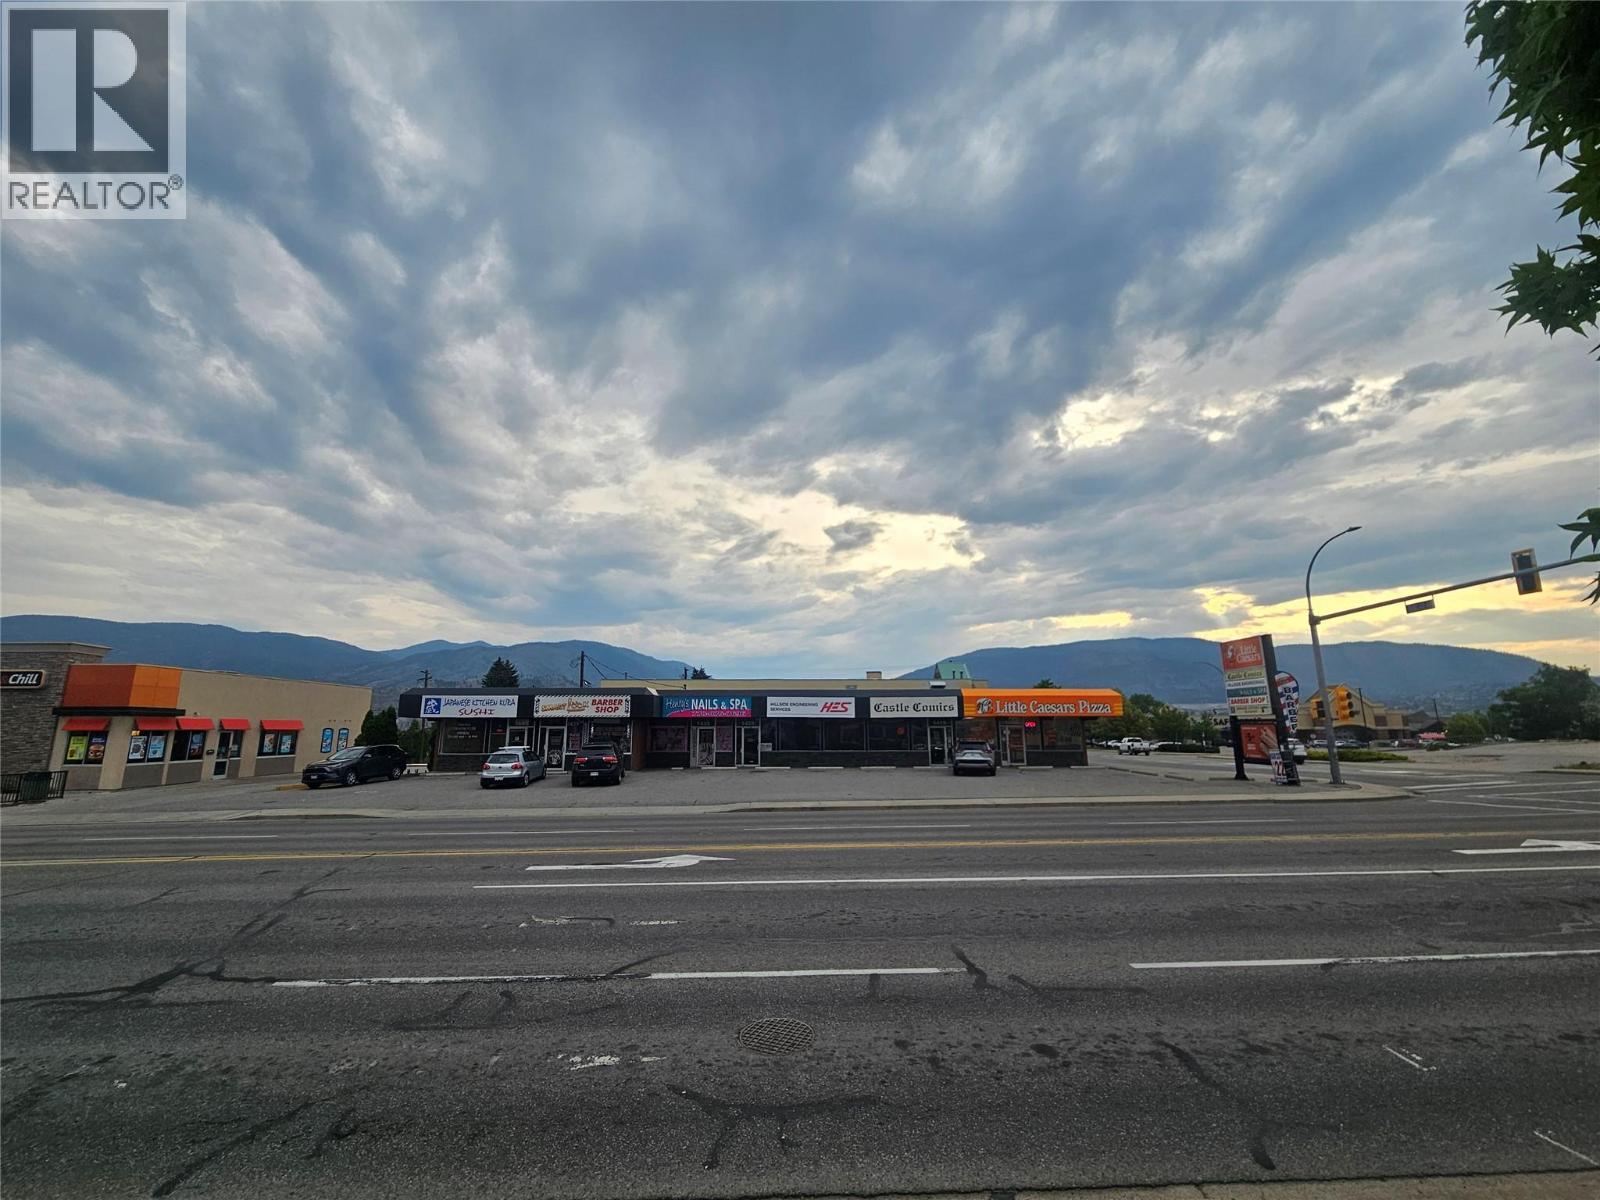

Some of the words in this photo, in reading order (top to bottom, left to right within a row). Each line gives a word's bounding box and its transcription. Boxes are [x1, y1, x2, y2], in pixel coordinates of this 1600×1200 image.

[8, 673, 39, 684] Chill
[443, 698, 471, 707] JAPANESE
[591, 698, 624, 706] BARBER
[691, 698, 718, 710] NAILS
[720, 701, 727, 710] &
[729, 698, 748, 710] SPA
[820, 702, 852, 712] HES
[873, 702, 910, 712] Castle
[912, 702, 955, 712] Comics
[995, 700, 1026, 714] Little
[1028, 700, 1074, 714] Caesars
[1077, 700, 1111, 714] Pizza
[458, 707, 496, 716] SUSHI
